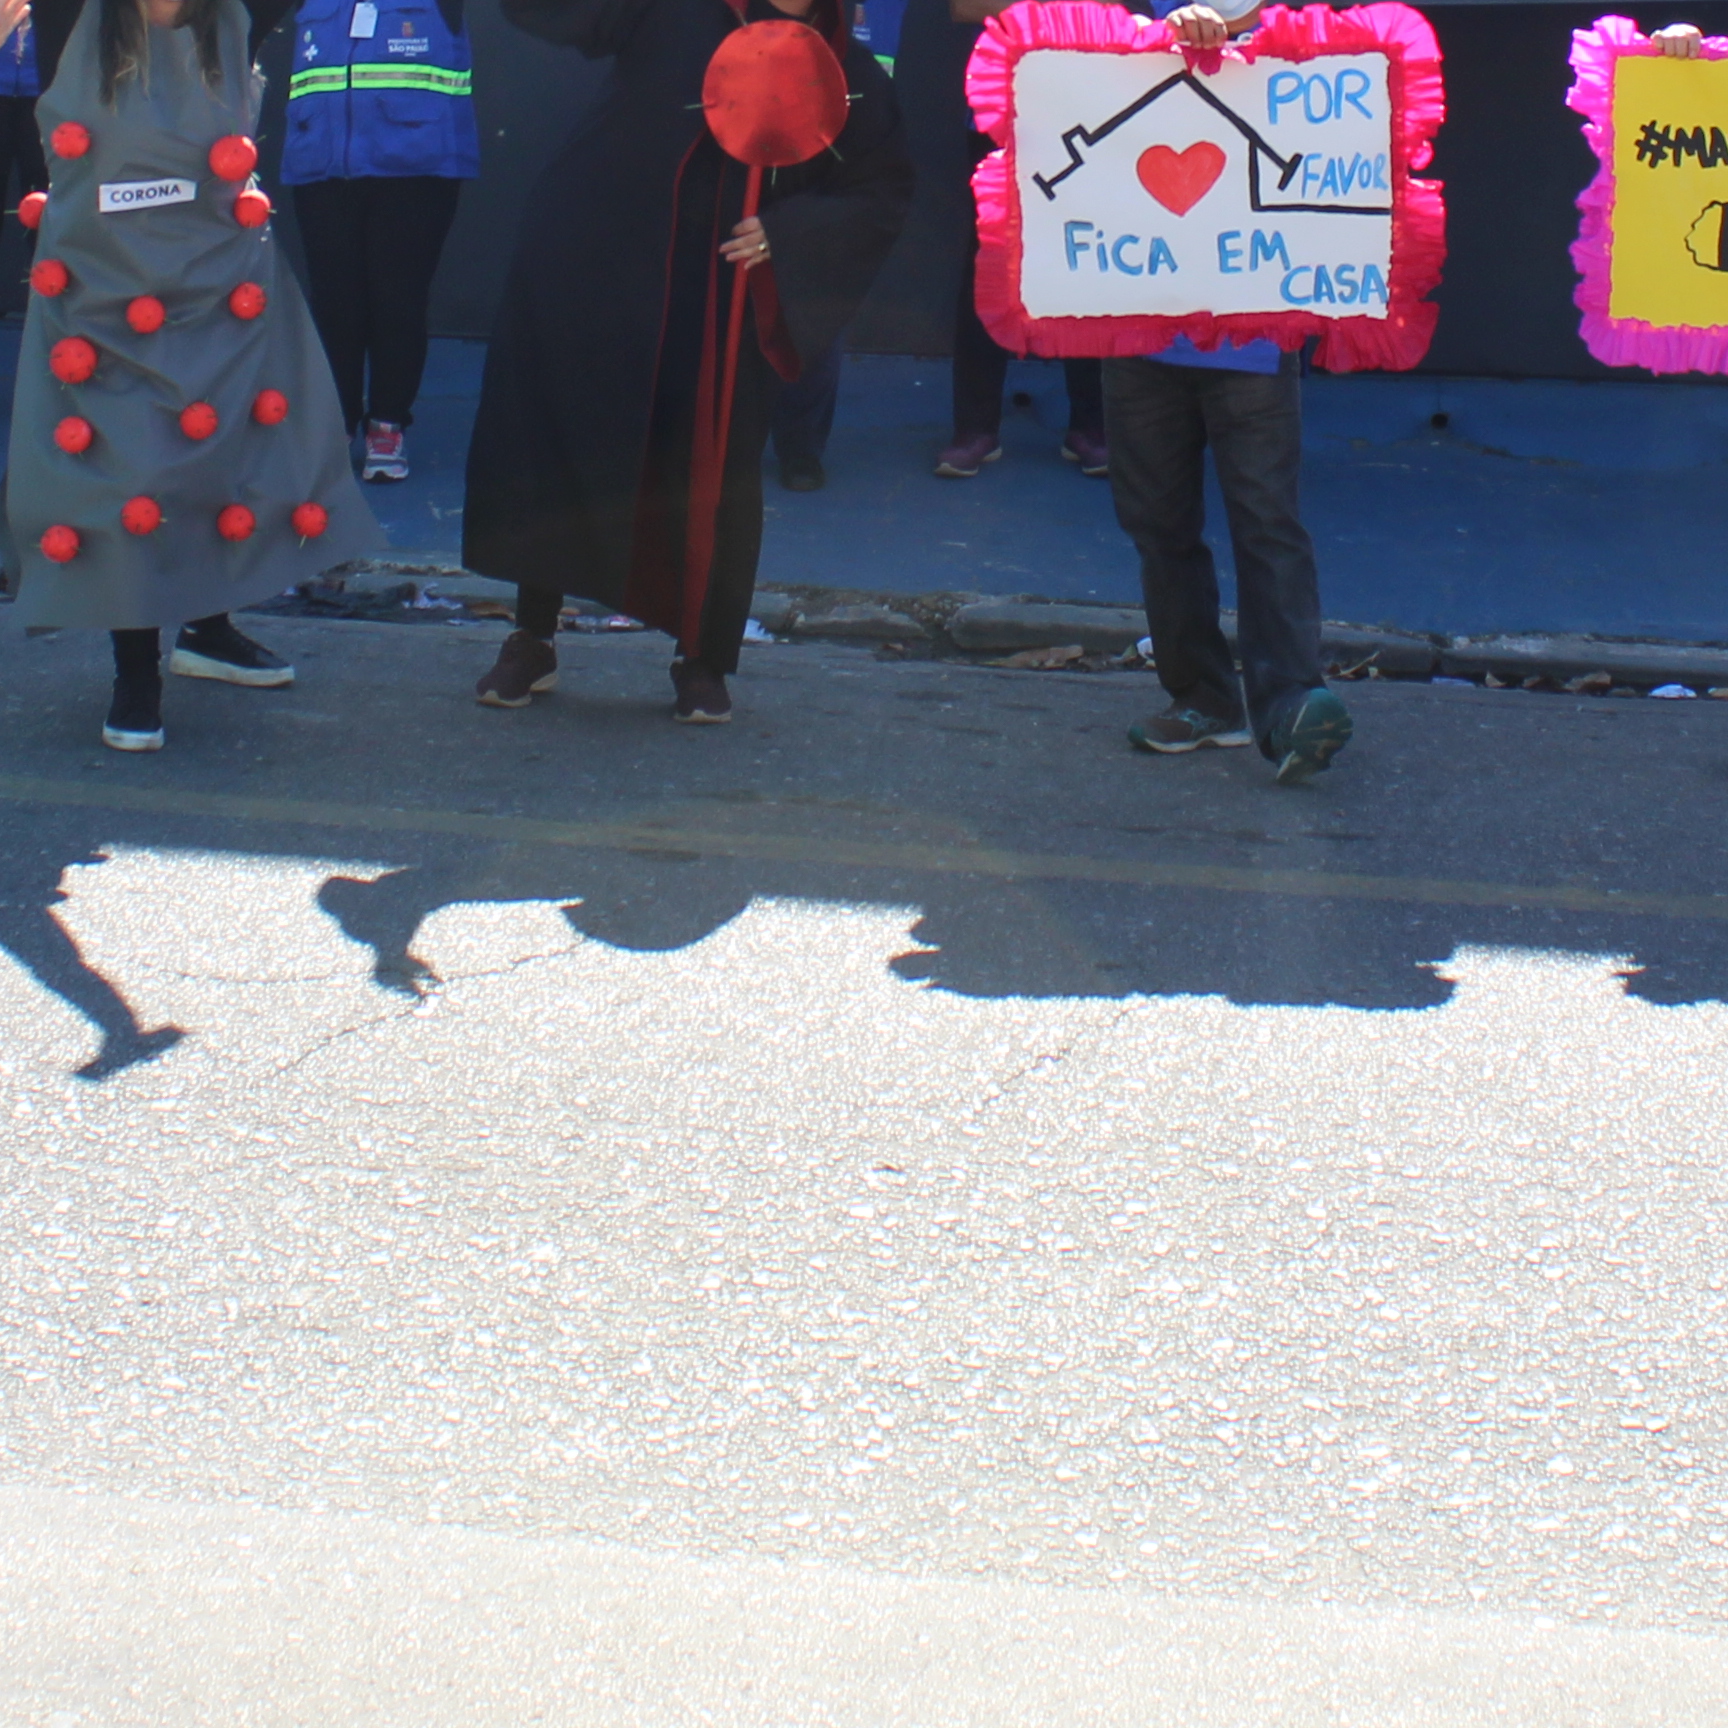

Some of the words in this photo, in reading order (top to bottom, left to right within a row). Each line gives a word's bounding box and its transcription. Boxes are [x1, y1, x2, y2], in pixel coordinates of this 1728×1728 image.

[1268, 69, 1372, 125] POR
[110, 184, 181, 203] CORONA
[1302, 152, 1390, 198] FAVOR
[1218, 230, 1291, 274] EM
[1280, 264, 1388, 305] CASA
